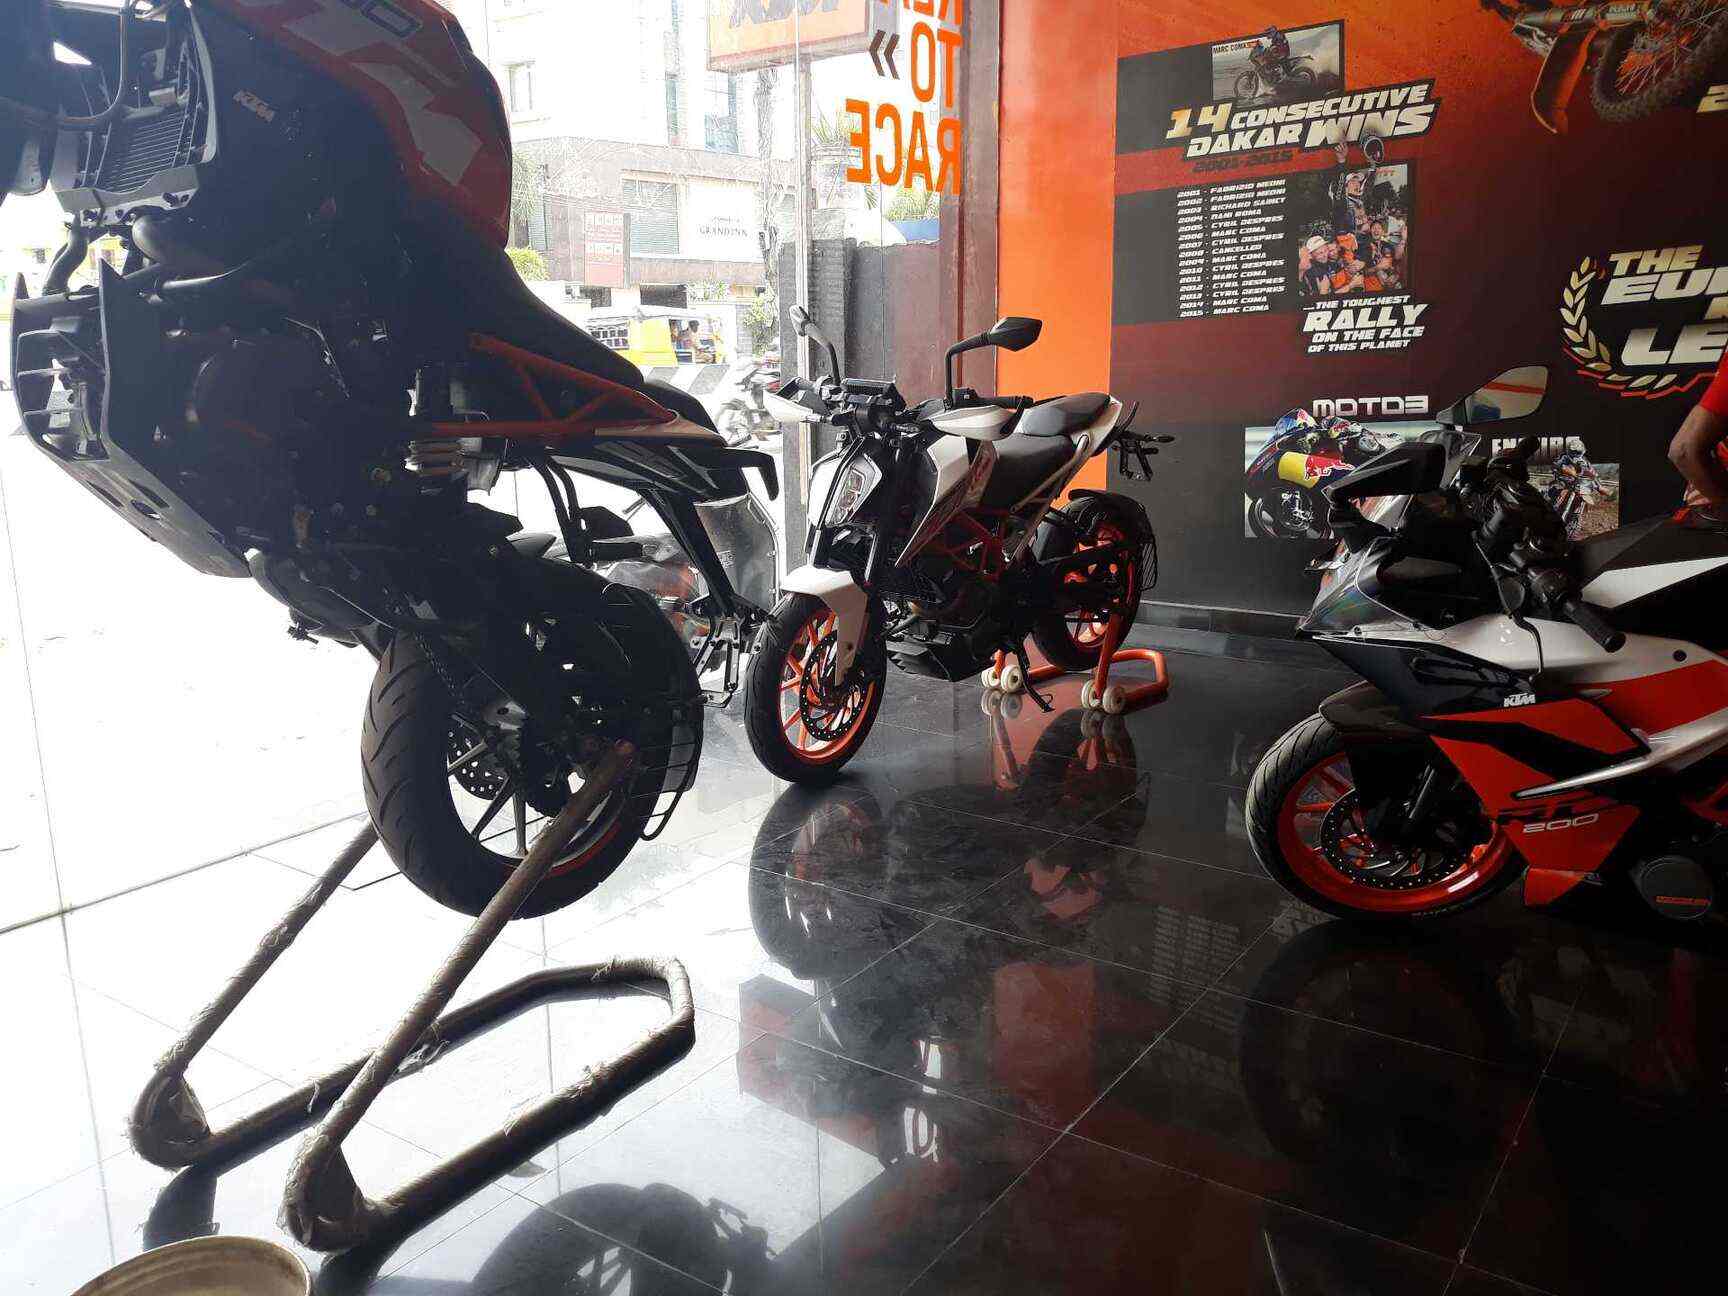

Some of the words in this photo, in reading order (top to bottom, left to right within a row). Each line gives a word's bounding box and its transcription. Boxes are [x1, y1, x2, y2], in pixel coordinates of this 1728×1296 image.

[1166, 102, 1233, 139] 14
[1230, 84, 1430, 129] CONSECUTIVE
[1186, 121, 1302, 158] DAKAR
[1304, 104, 1435, 148] WINS
[1211, 202, 1251, 211] RICHARD
[1178, 224, 1204, 232] 2005
[1178, 233, 1203, 241] 2006
[1211, 229, 1238, 237] MARC
[1239, 226, 1266, 234] COMA
[1212, 244, 1262, 255] CANCELLED
[1212, 255, 1238, 263] MARC
[1609, 245, 1703, 276] THE
[1179, 267, 1203, 275] 2010
[1180, 276, 1201, 284] 2011
[1240, 270, 1266, 278] COMA
[1342, 295, 1411, 307] TOUGHEST
[1213, 307, 1240, 315] MARC
[1242, 304, 1269, 312] COMA
[1303, 304, 1429, 332] RALLY
[1312, 332, 1338, 343] ON
[1343, 329, 1376, 341] THE
[1379, 326, 1425, 339] FACE
[1307, 344, 1326, 353] OF
[1328, 342, 1358, 352] THIS
[1360, 340, 1411, 350] PLANET
[1312, 395, 1429, 418] MOTO3
[1503, 693, 1535, 708] KTM
[1523, 813, 1600, 834] 200
